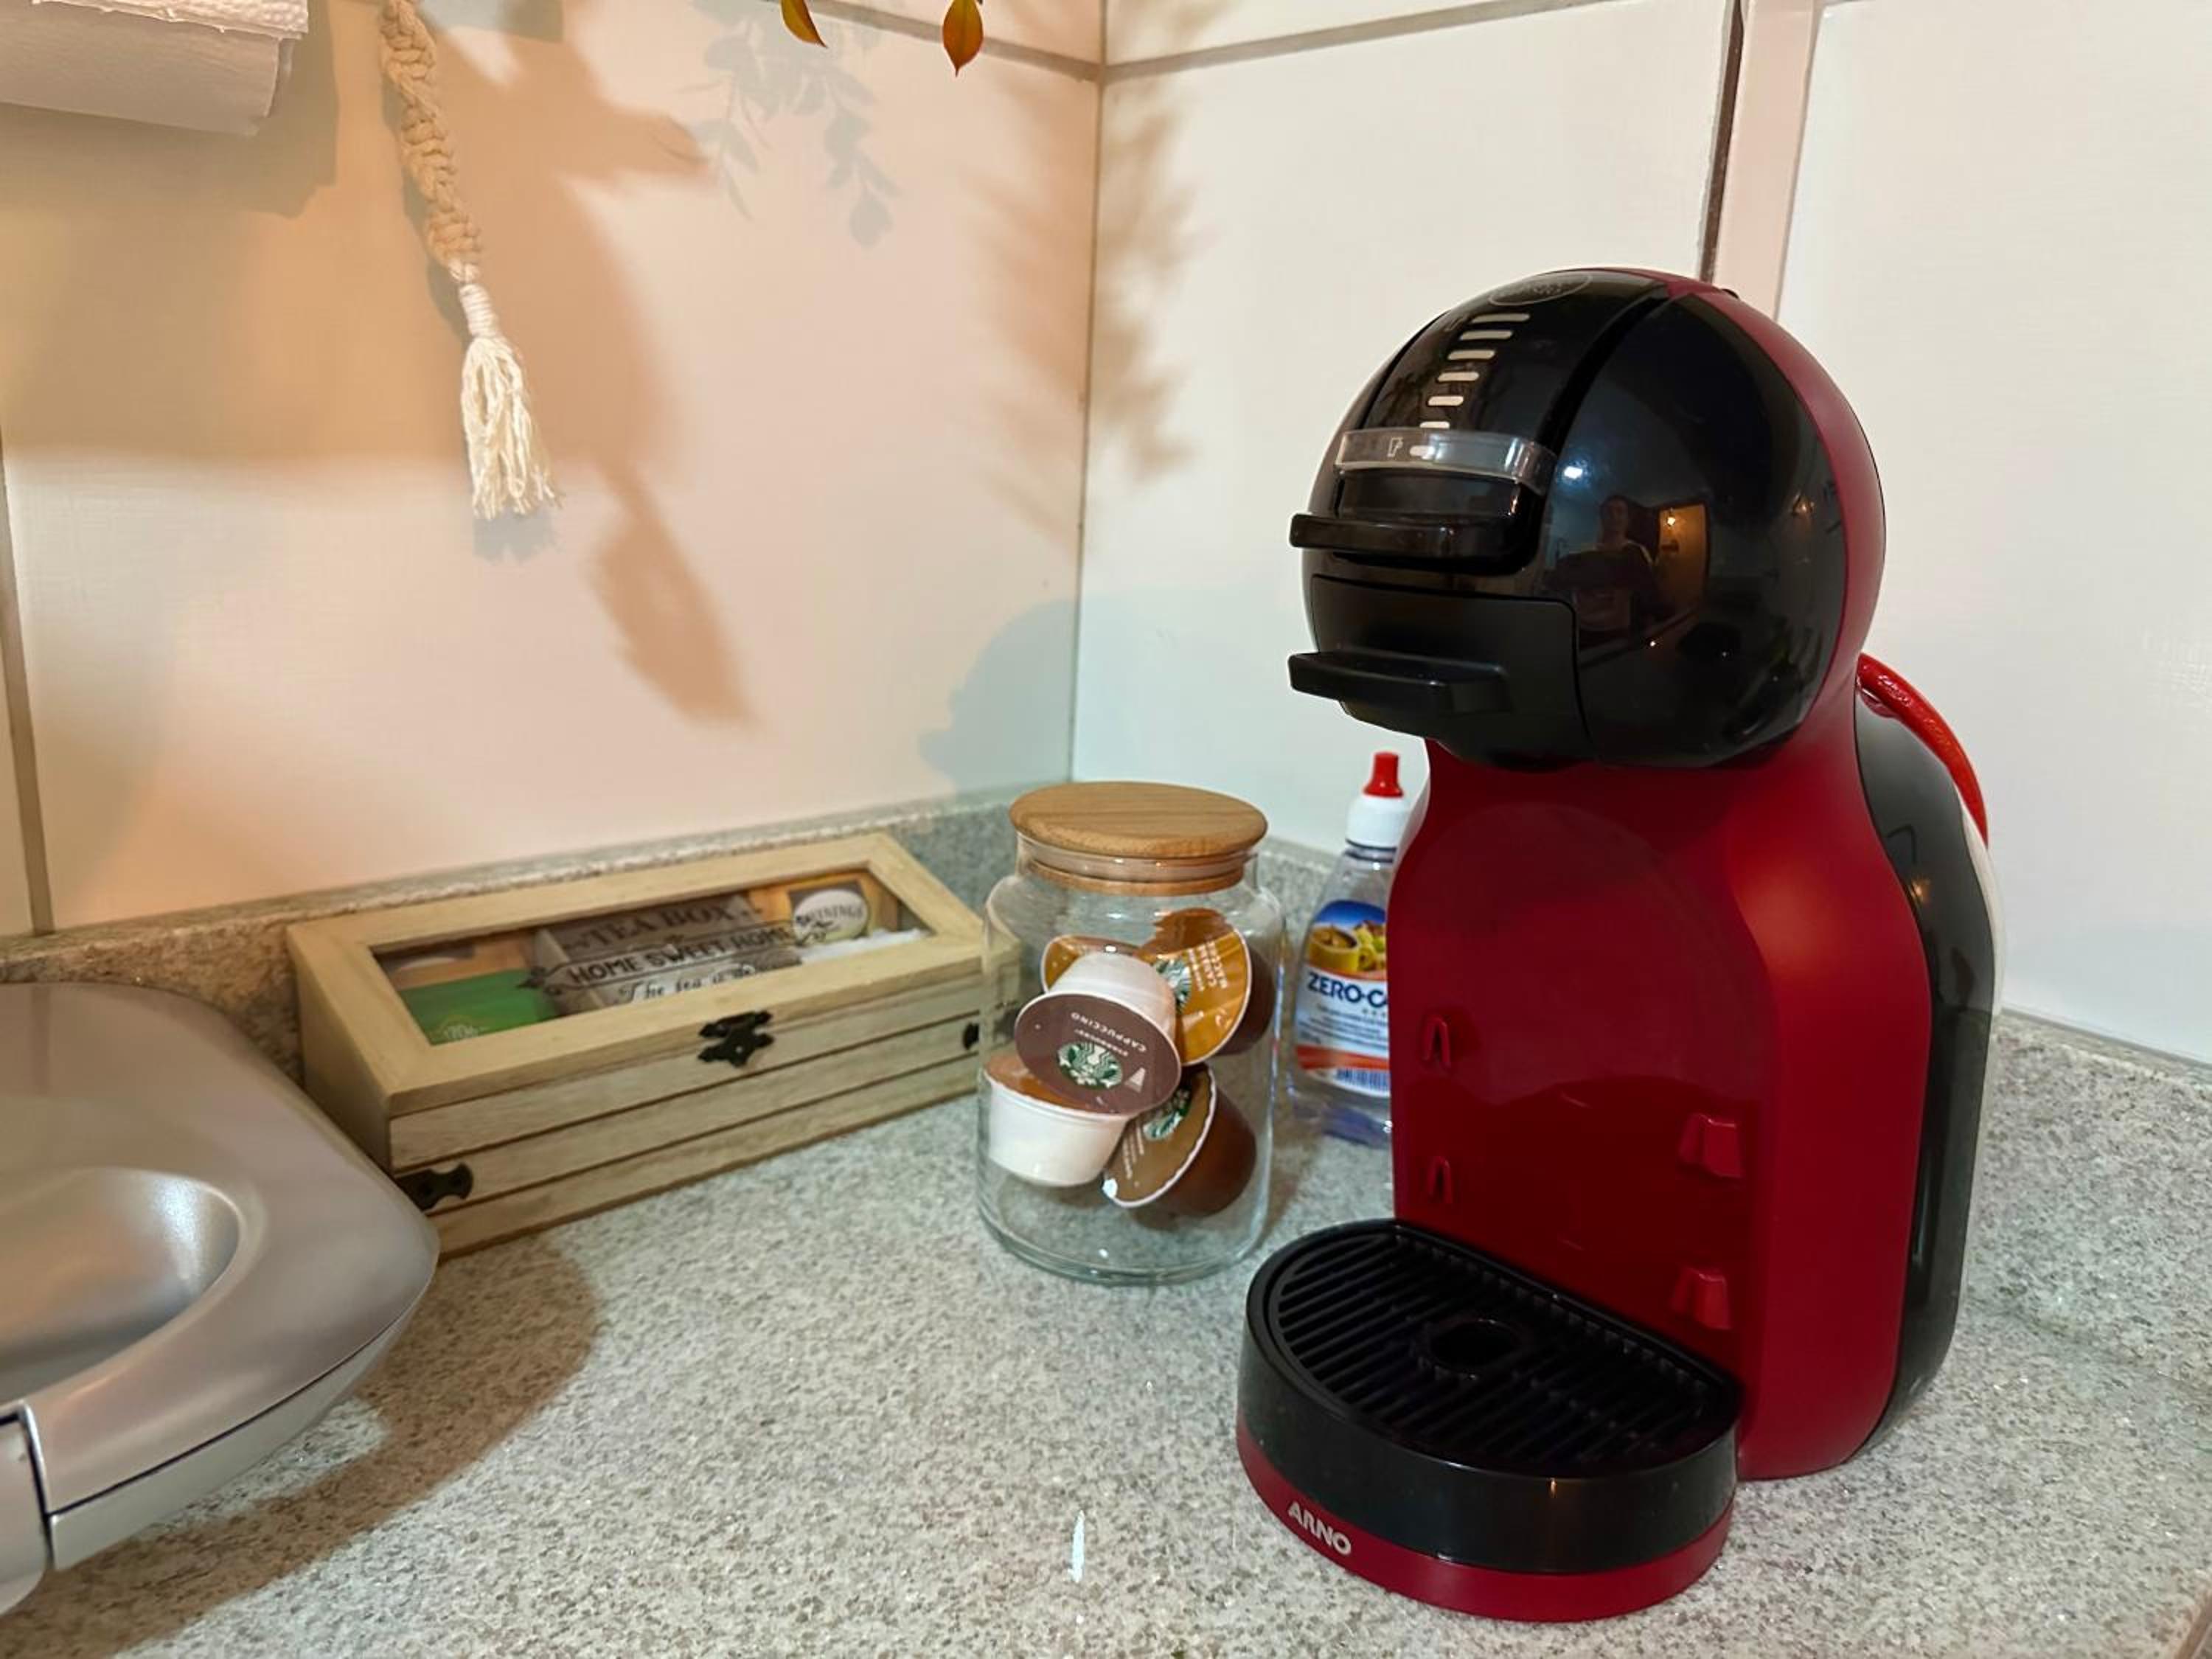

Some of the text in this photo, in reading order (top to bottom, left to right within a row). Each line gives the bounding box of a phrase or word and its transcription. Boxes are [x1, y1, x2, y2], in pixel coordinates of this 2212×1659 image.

[588, 904, 735, 946] TEA BOX
[568, 956, 644, 984] HOME
[646, 938, 728, 968] SWEET
[1307, 971, 1388, 1008] ZERO-C
[1070, 1012, 1147, 1053] CAPPUCCINO
[1288, 1501, 1352, 1556] ARNO
